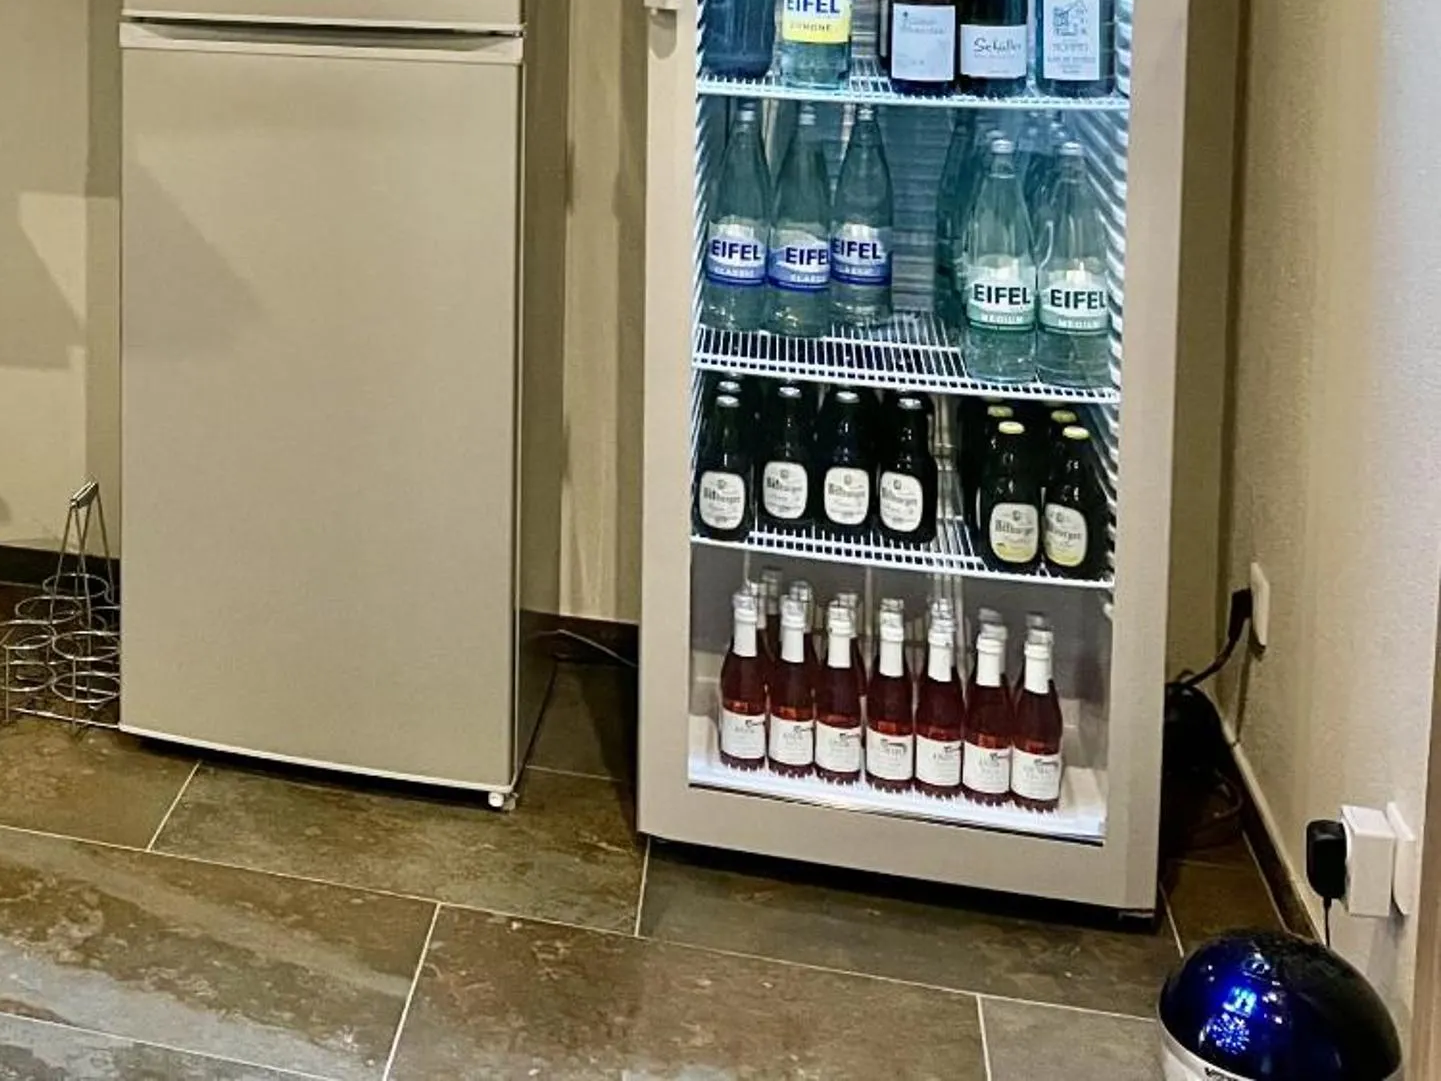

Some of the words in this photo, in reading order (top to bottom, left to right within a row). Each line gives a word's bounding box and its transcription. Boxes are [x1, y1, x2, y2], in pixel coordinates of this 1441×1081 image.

[712, 239, 761, 261] EIFEL
[785, 247, 829, 266] EIFE
[832, 238, 882, 260] EIFEL
[973, 283, 1031, 305] EIFEL
[1050, 289, 1106, 310] EIFEL
